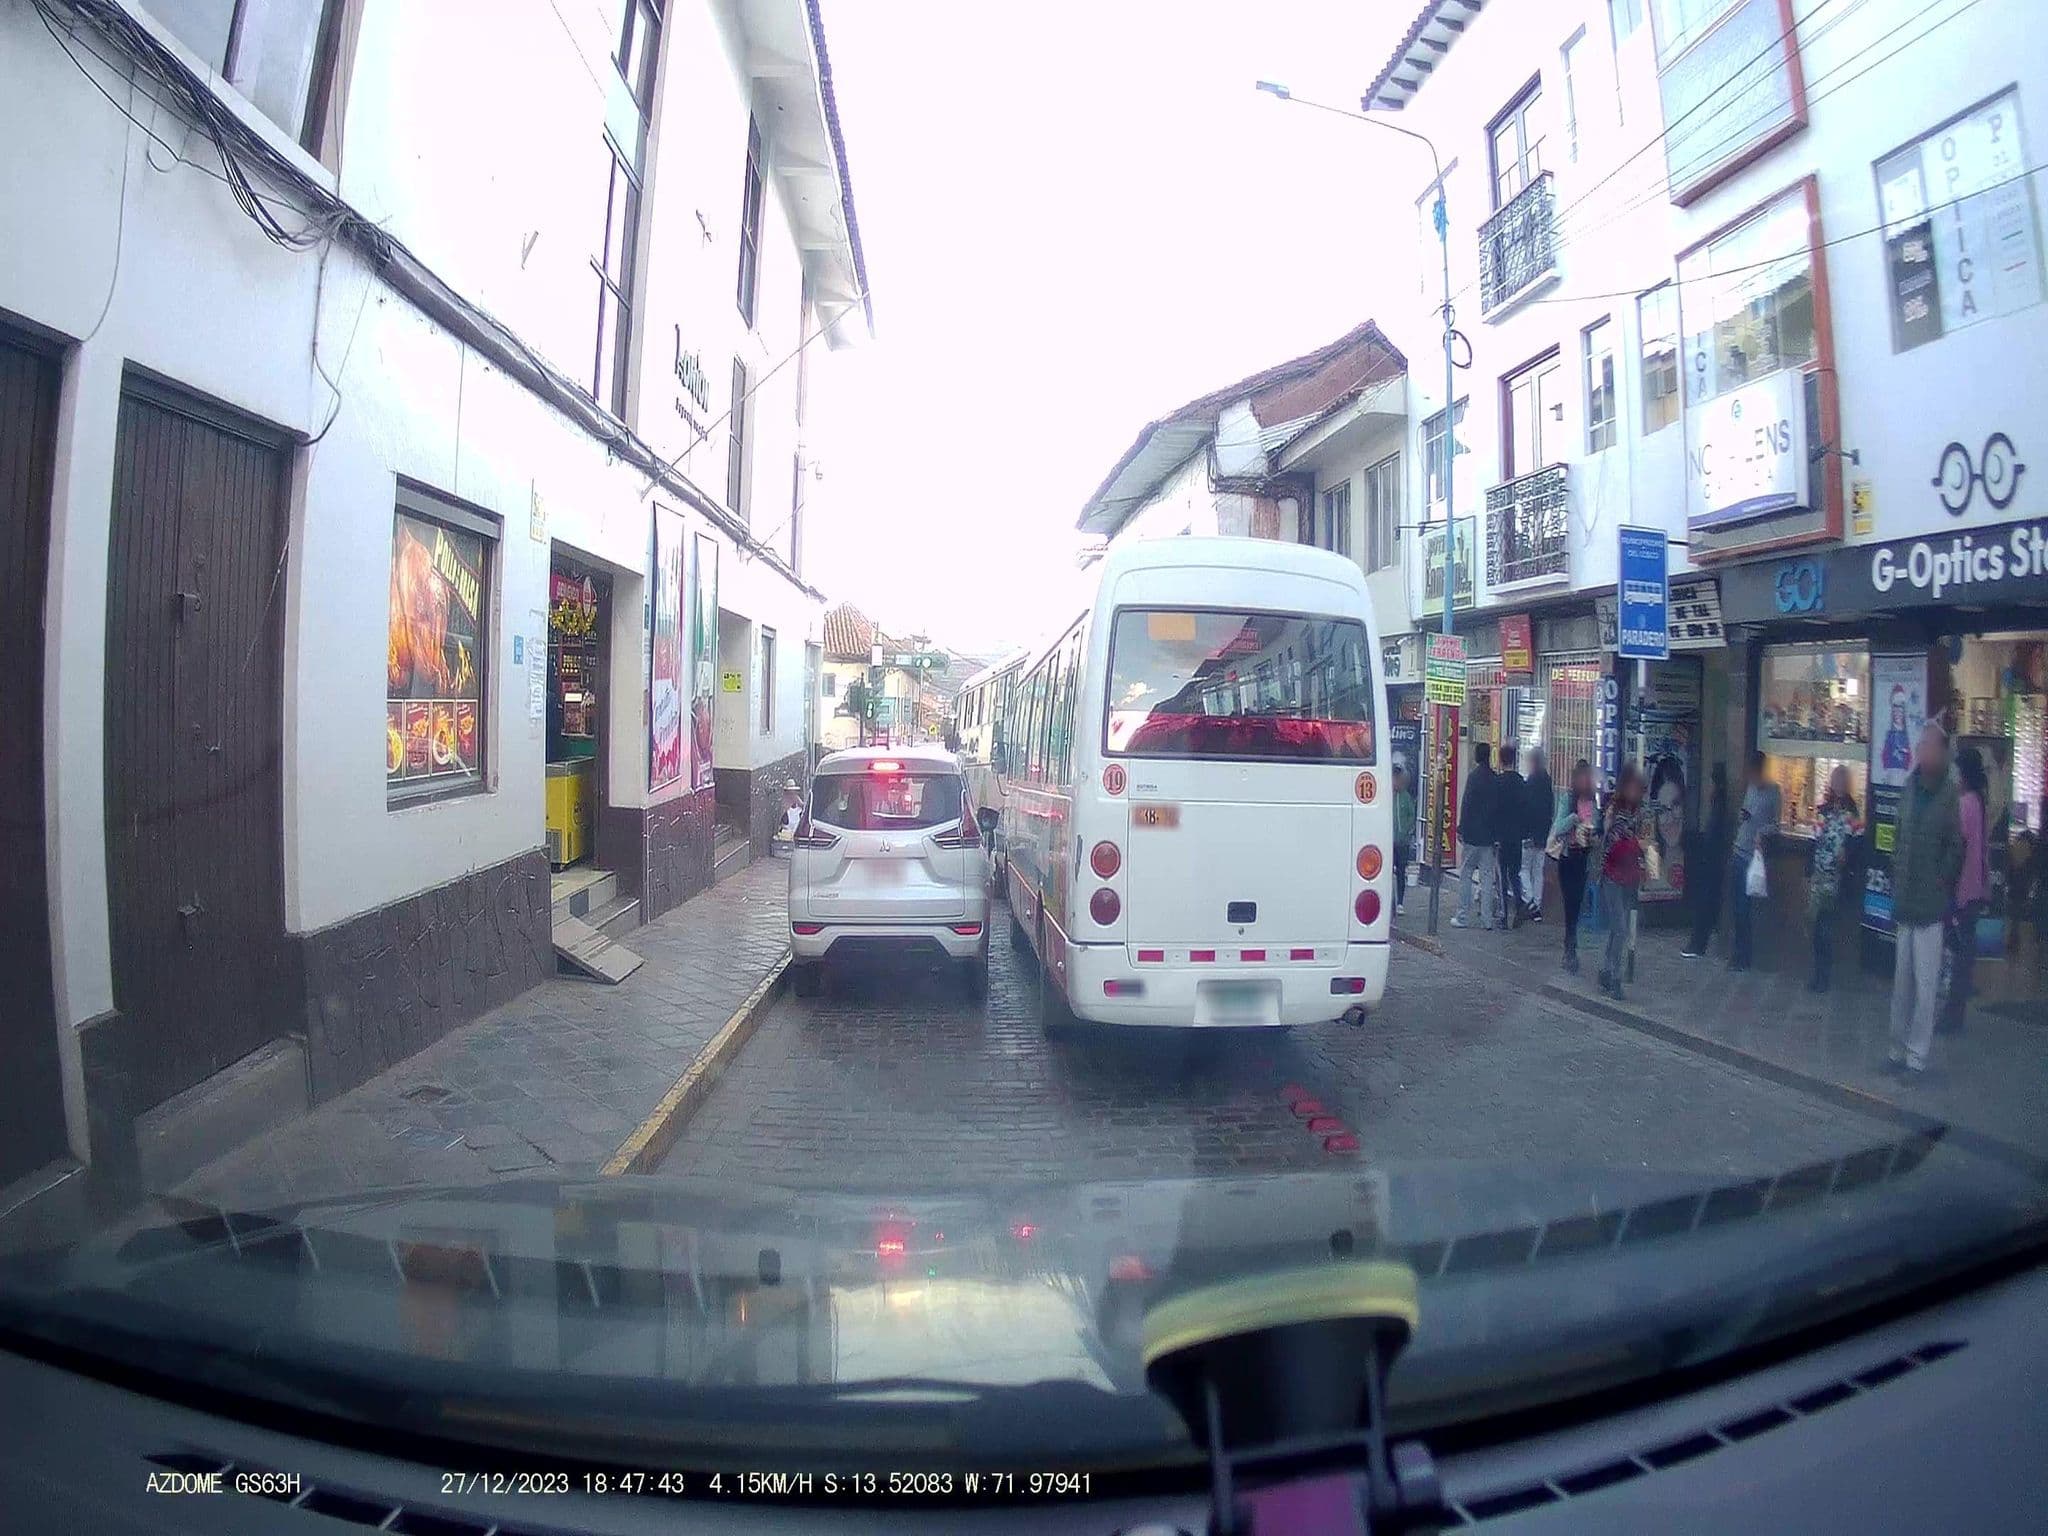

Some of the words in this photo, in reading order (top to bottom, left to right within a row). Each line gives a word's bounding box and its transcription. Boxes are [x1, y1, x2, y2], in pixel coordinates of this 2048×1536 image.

[1871, 535, 2005, 599] G-Optics
[2010, 526, 2048, 577] St
[1621, 628, 1665, 648] PARADERO
[1551, 668, 1565, 681] DE
[1360, 781, 1373, 799] 13
